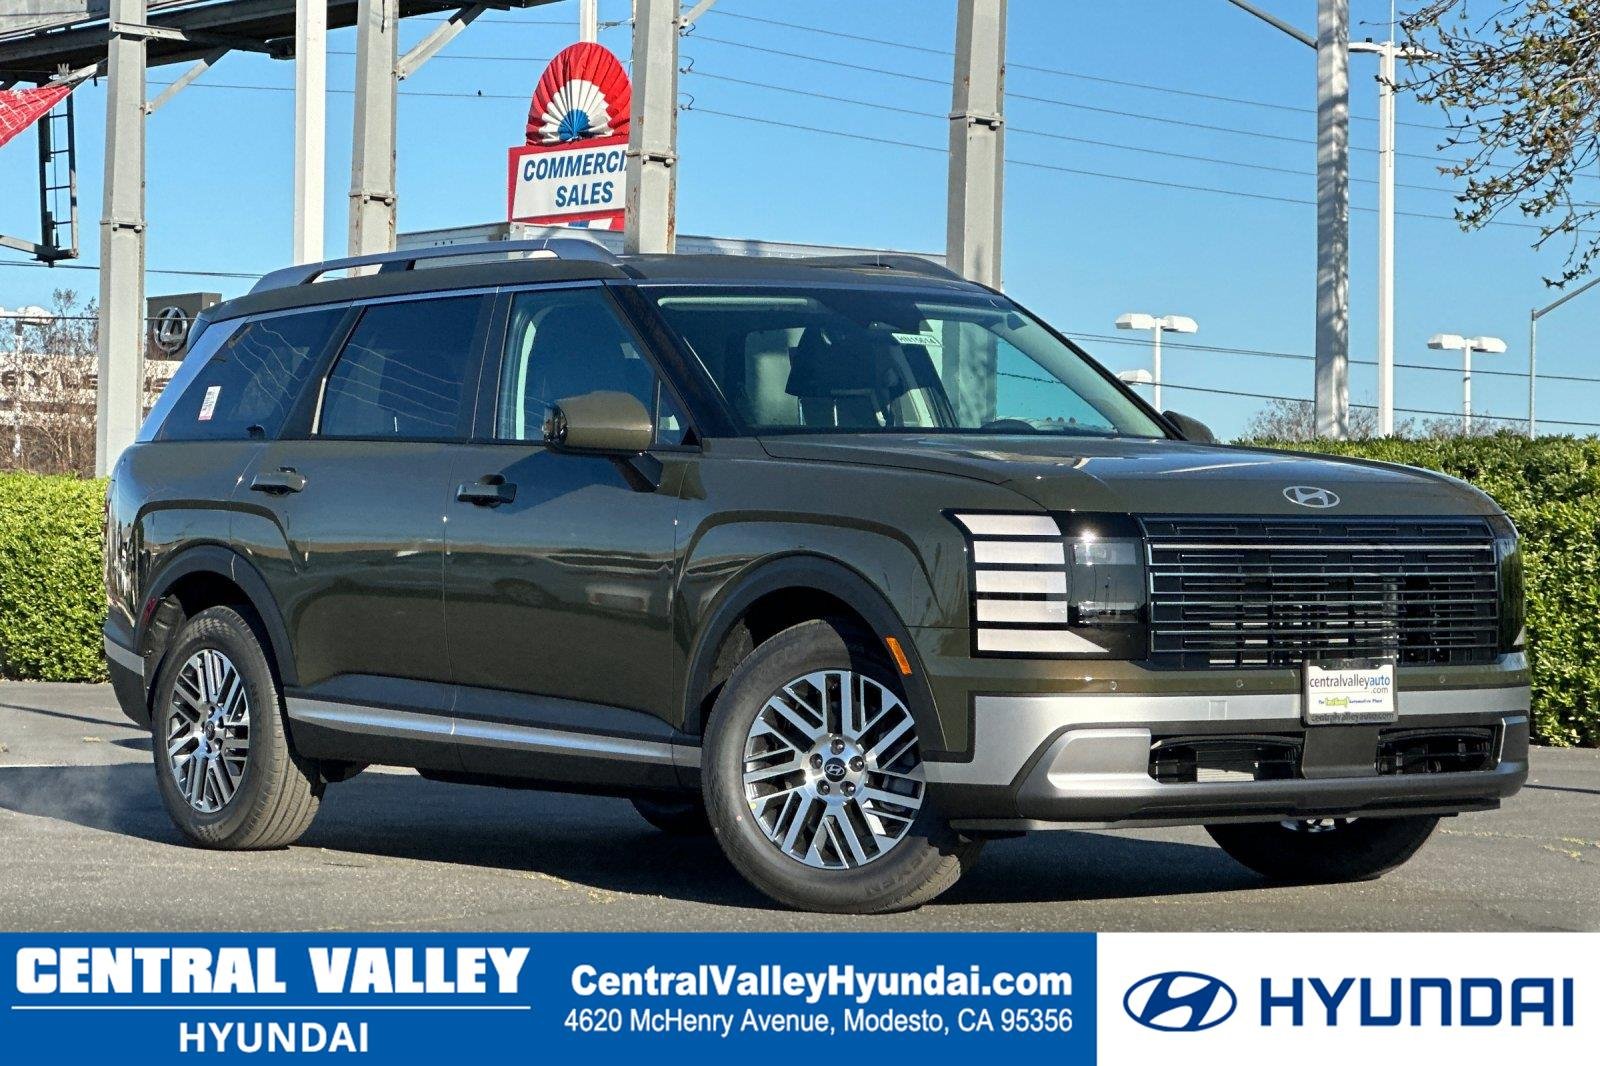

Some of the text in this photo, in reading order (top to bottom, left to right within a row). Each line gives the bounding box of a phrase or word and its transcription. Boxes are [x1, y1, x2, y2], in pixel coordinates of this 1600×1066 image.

[523, 150, 626, 182] COMMERCI
[555, 181, 614, 208] SALES
[1310, 674, 1390, 689] centralvalleyauto
